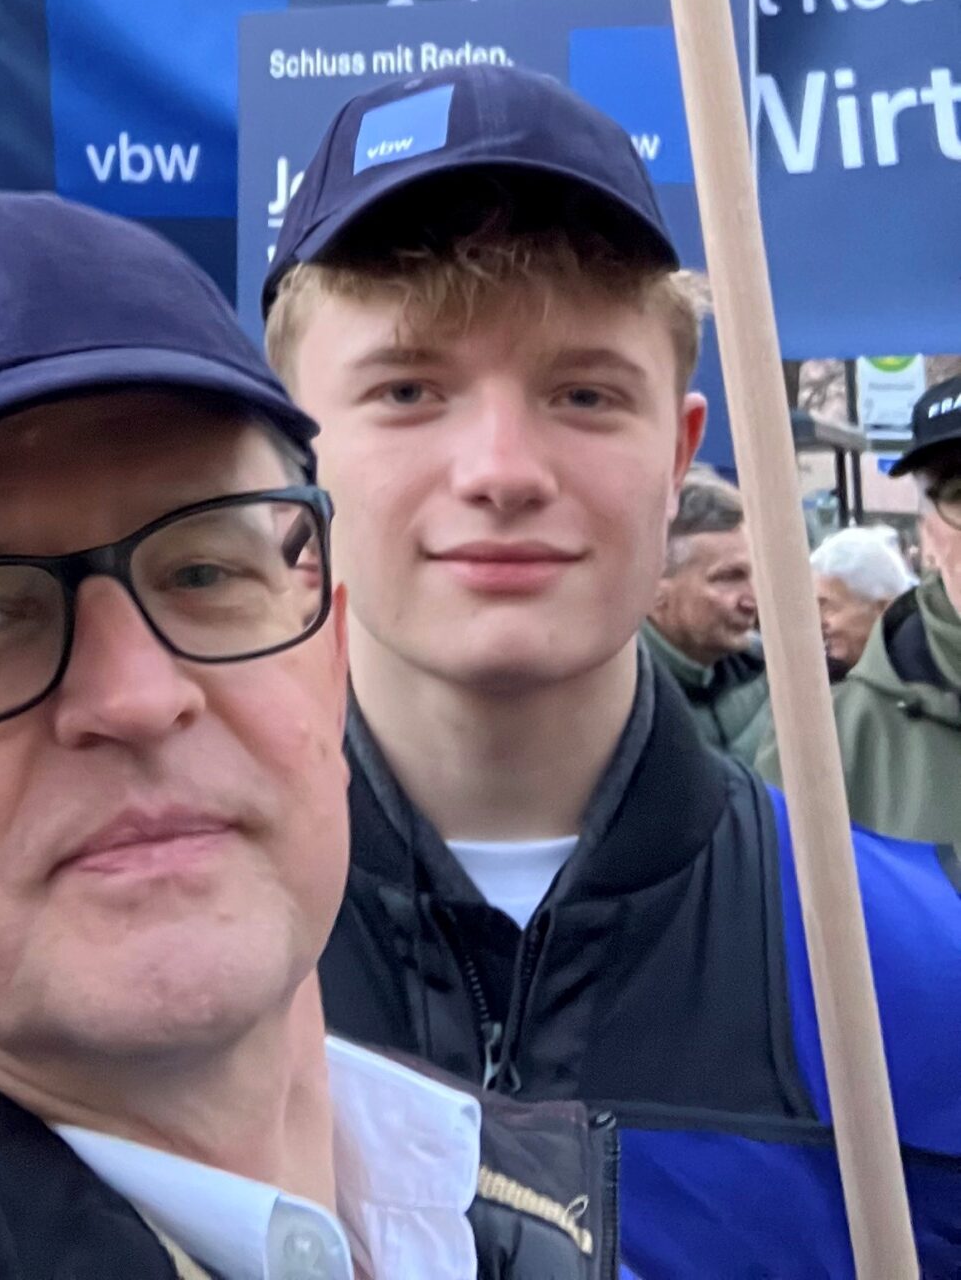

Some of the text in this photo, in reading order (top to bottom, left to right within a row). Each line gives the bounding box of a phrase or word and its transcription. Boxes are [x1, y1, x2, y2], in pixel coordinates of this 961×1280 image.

[270, 48, 365, 79] Schluss
[372, 43, 413, 74] mit
[85, 131, 201, 183] vbw
[366, 136, 414, 159] vbw
